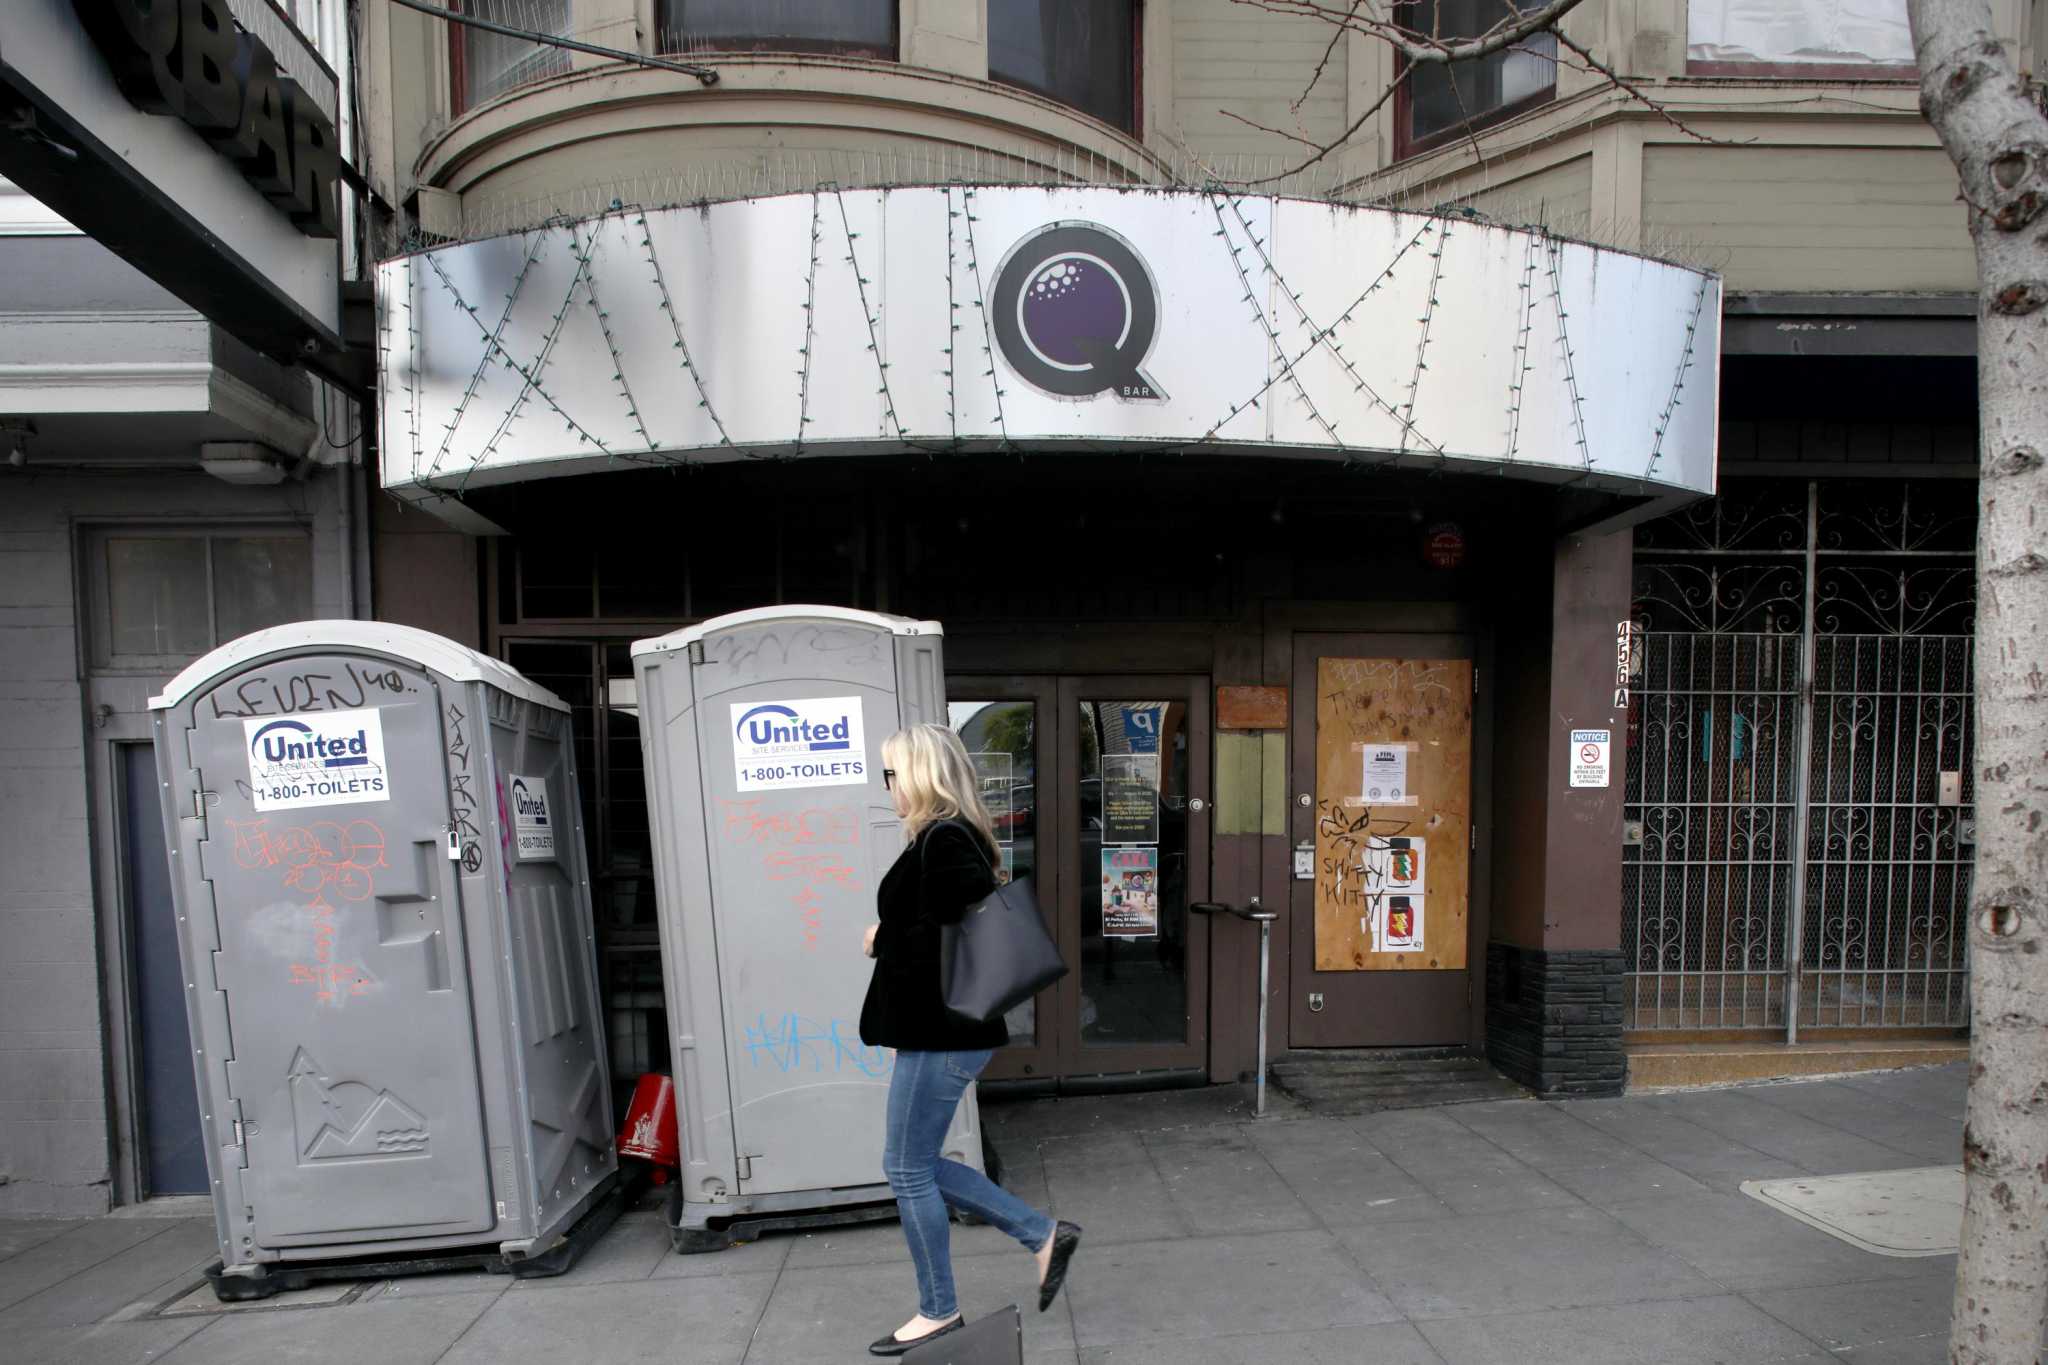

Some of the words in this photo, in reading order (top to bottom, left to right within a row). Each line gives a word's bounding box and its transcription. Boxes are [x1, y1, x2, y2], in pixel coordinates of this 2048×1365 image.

[988, 222, 1168, 401] Q
[1123, 386, 1149, 396] BAR
[1615, 622, 1630, 707] 456A
[750, 715, 850, 745] United
[1574, 732, 1608, 742] NOTICE
[263, 729, 368, 762] United
[751, 746, 770, 755] SITE
[771, 743, 809, 754] SERVICES
[740, 761, 864, 783] 1-800-TOILETS
[258, 777, 384, 801] 1-800-TOILETS
[515, 791, 546, 816] United
